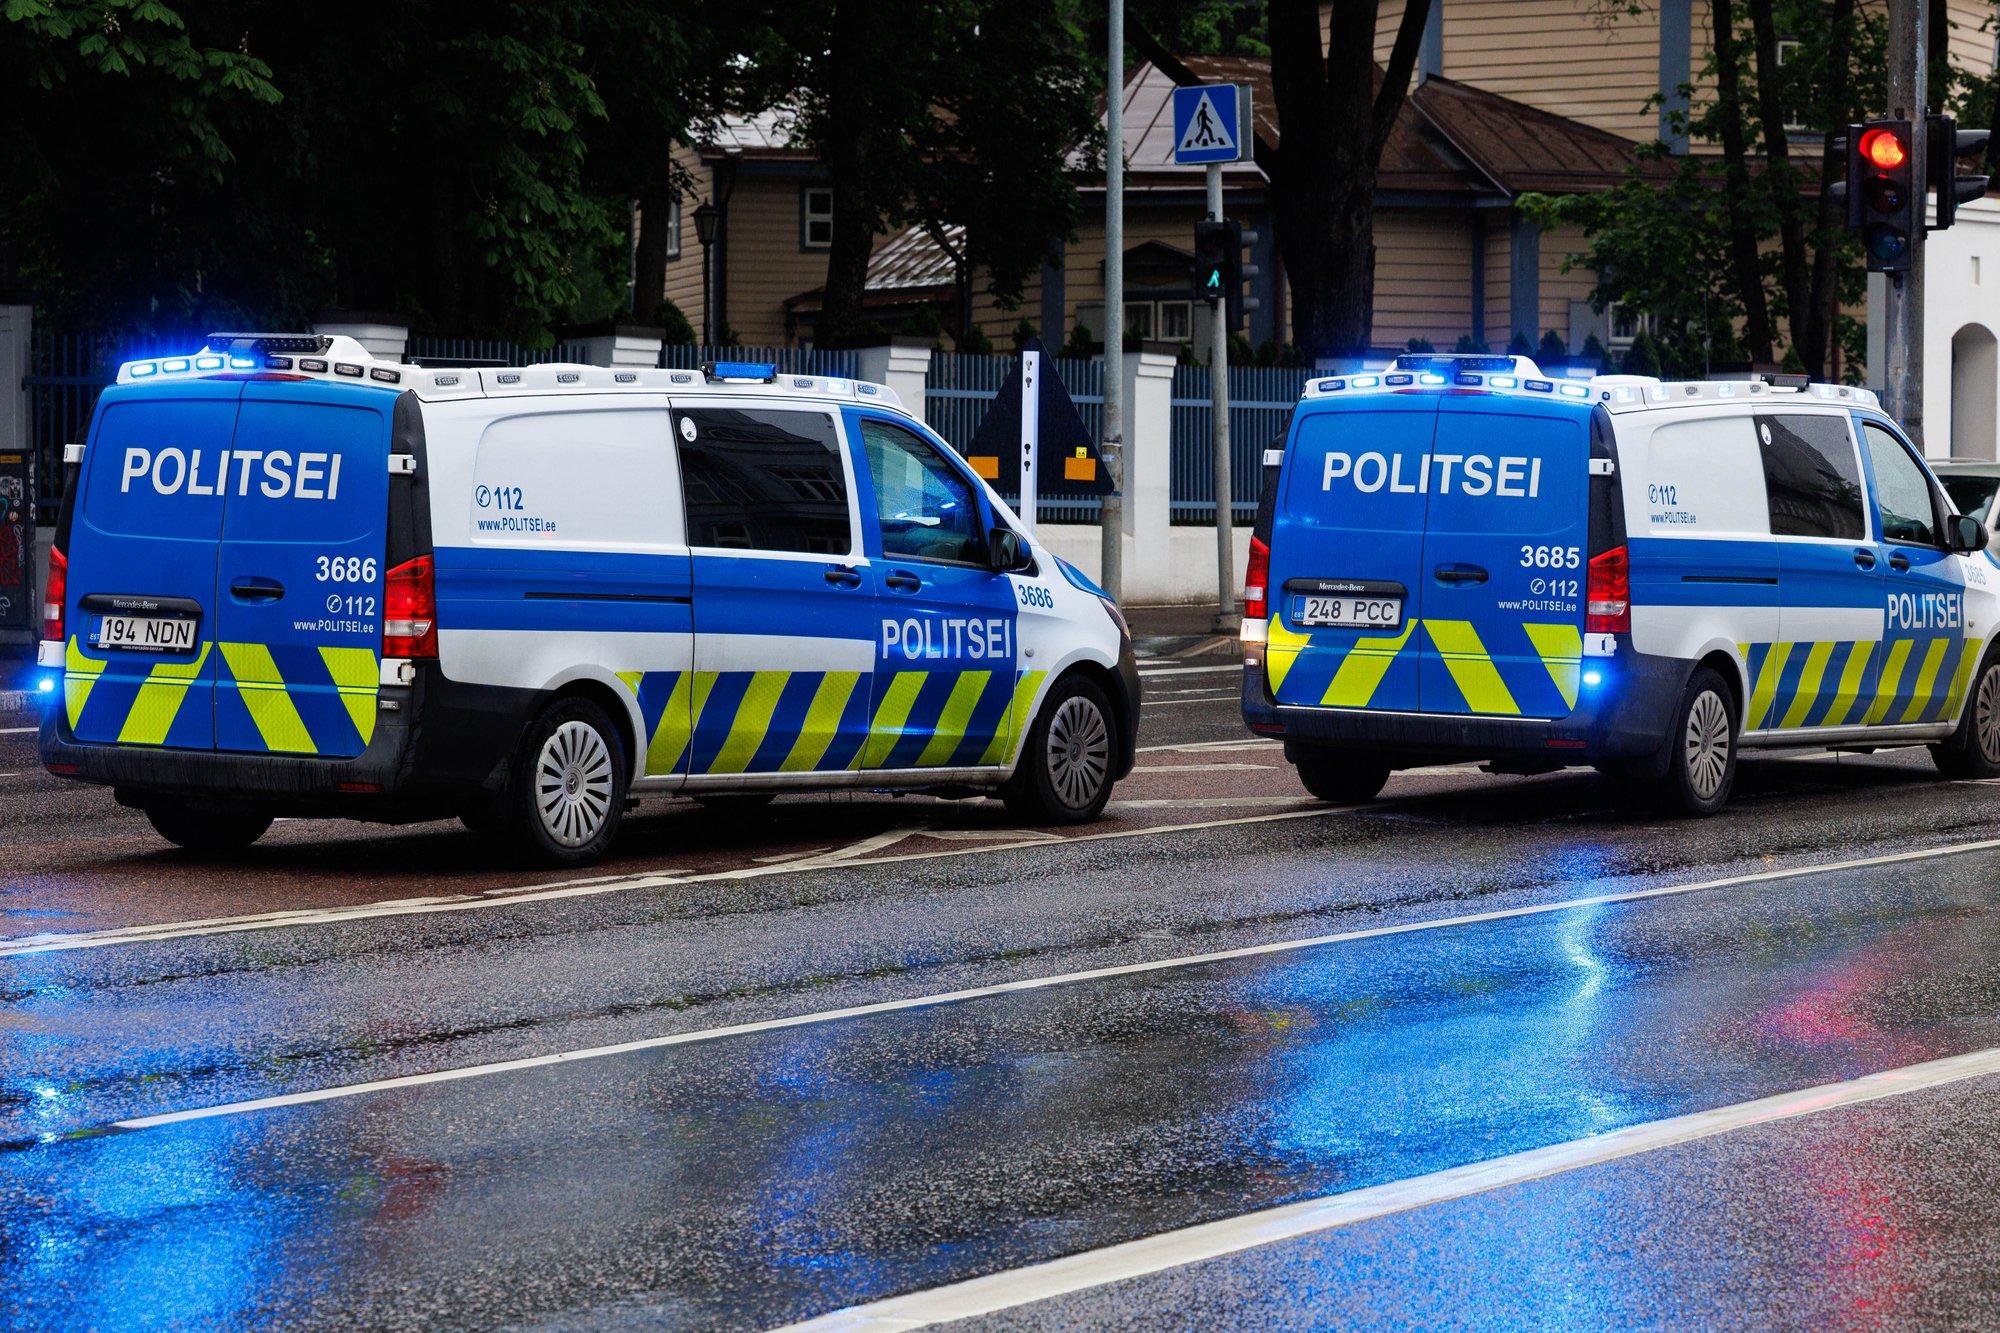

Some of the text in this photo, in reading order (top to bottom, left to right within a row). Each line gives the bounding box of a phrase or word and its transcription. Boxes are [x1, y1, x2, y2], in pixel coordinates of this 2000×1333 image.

[121, 447, 342, 500] POLITSEI
[1322, 451, 1542, 498] POLITSEI
[494, 486, 524, 510] 112
[1659, 485, 1677, 505] 112
[478, 517, 556, 532] www.POLITSEI.ee
[1520, 545, 1580, 569] 3685
[315, 556, 377, 583] 3686
[1018, 584, 1054, 609] 3686
[1318, 582, 1365, 592] Mercedes-Benz
[1549, 579, 1578, 597] 112
[112, 599, 159, 610] Mercedes-Benz
[345, 596, 375, 616] 112
[1308, 599, 1394, 621] 248 PCC
[1498, 599, 1577, 612] www.POLITSEI.ee
[1887, 592, 1961, 630] POLITSEI
[105, 618, 190, 645] 194 NDN
[293, 619, 374, 633] www.POLITSEI.ee
[882, 617, 1011, 660] POLITSEI
